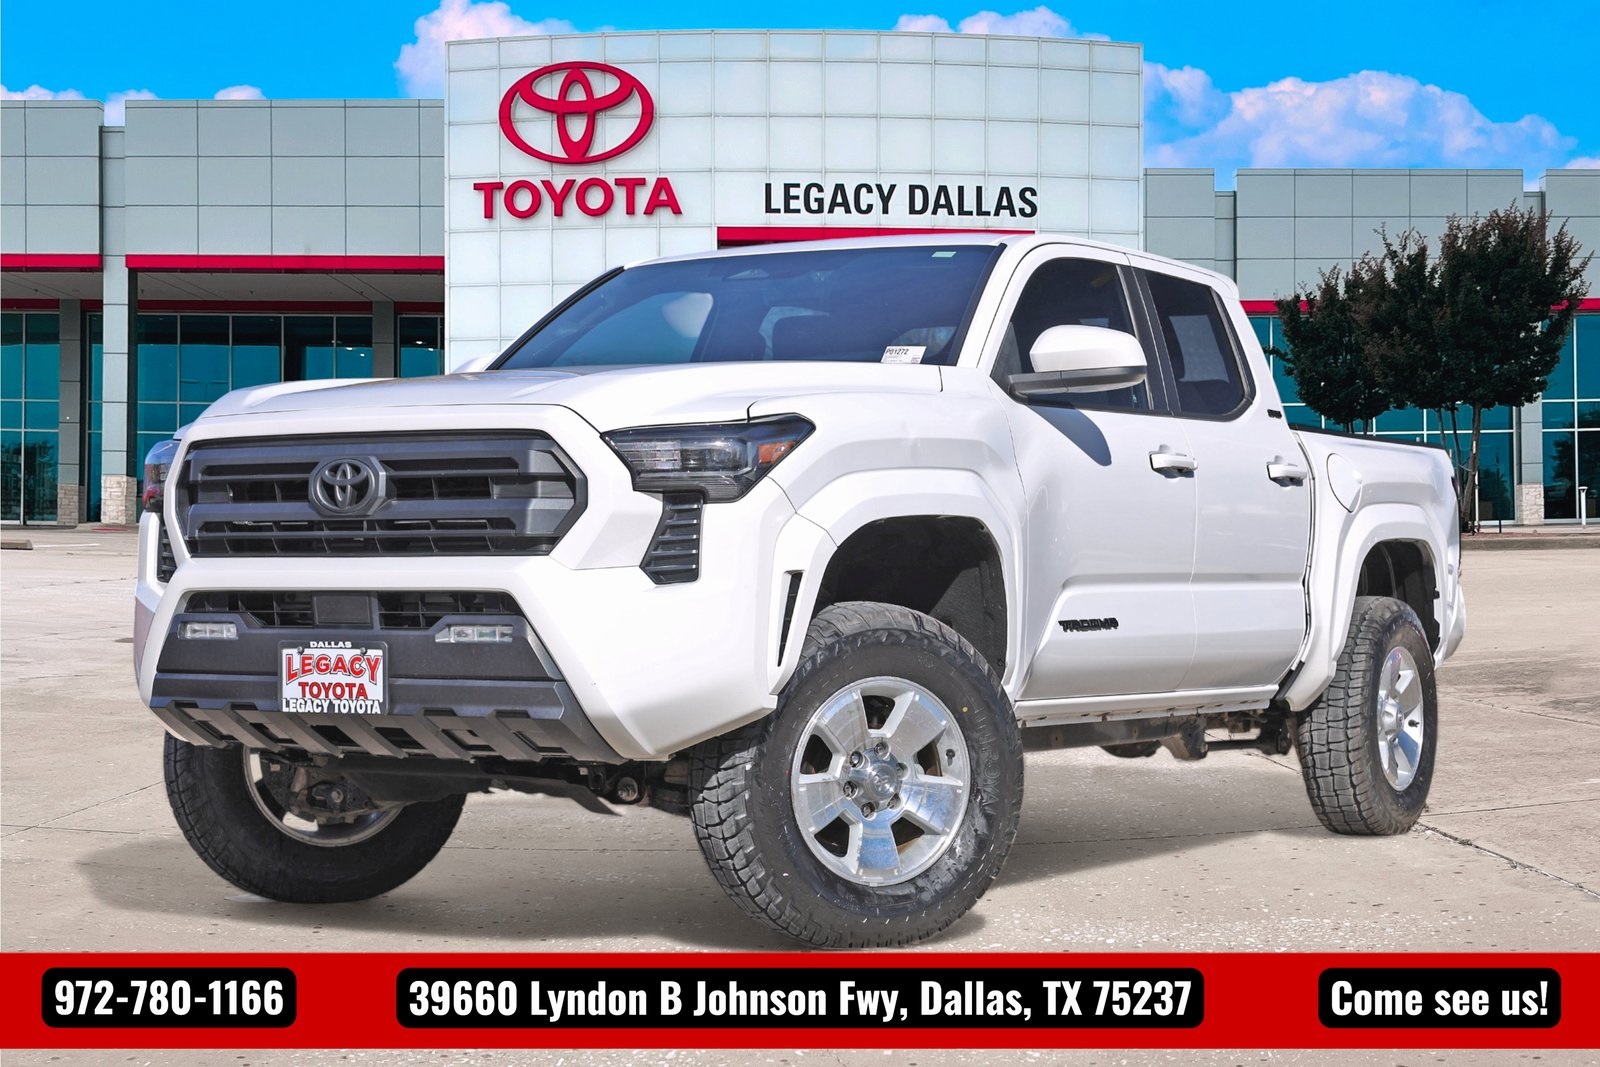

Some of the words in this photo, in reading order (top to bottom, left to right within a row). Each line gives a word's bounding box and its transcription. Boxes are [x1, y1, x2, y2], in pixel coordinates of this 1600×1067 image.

[474, 177, 682, 218] TOYOTA
[765, 183, 897, 215] LEGACY
[909, 185, 1037, 218] DALLAS
[286, 654, 382, 685] LEGACY
[282, 698, 329, 713] LEGACY
[331, 699, 381, 714] TOYOTA
[298, 682, 368, 700] TOYOTA
